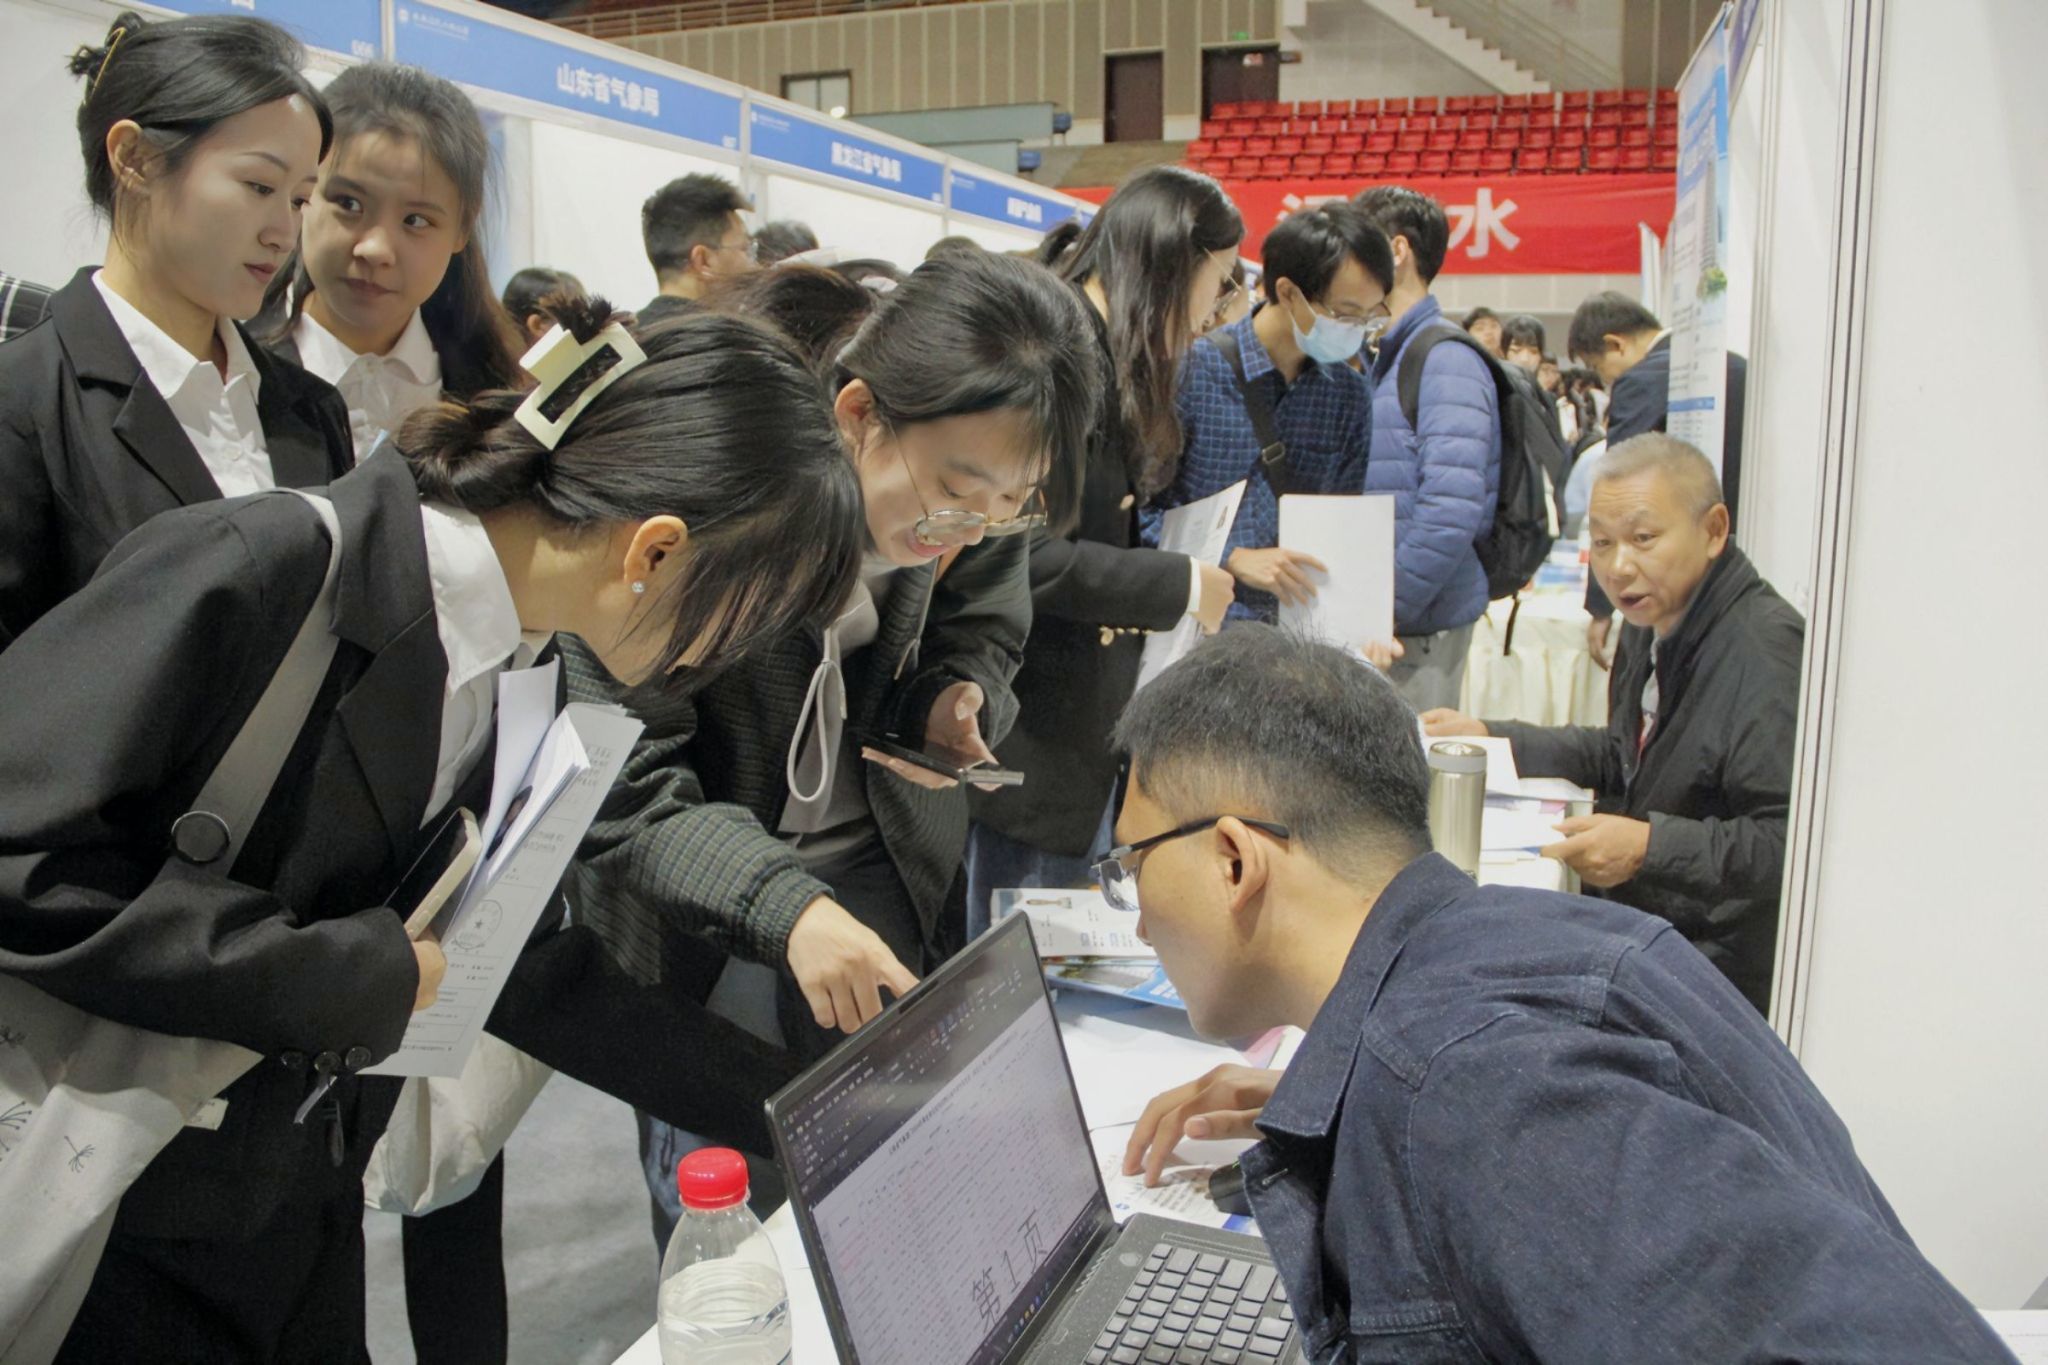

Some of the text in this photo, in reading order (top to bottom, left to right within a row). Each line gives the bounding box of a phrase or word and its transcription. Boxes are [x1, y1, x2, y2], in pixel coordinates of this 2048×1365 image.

[557, 62, 659, 117] 山东省气象局
